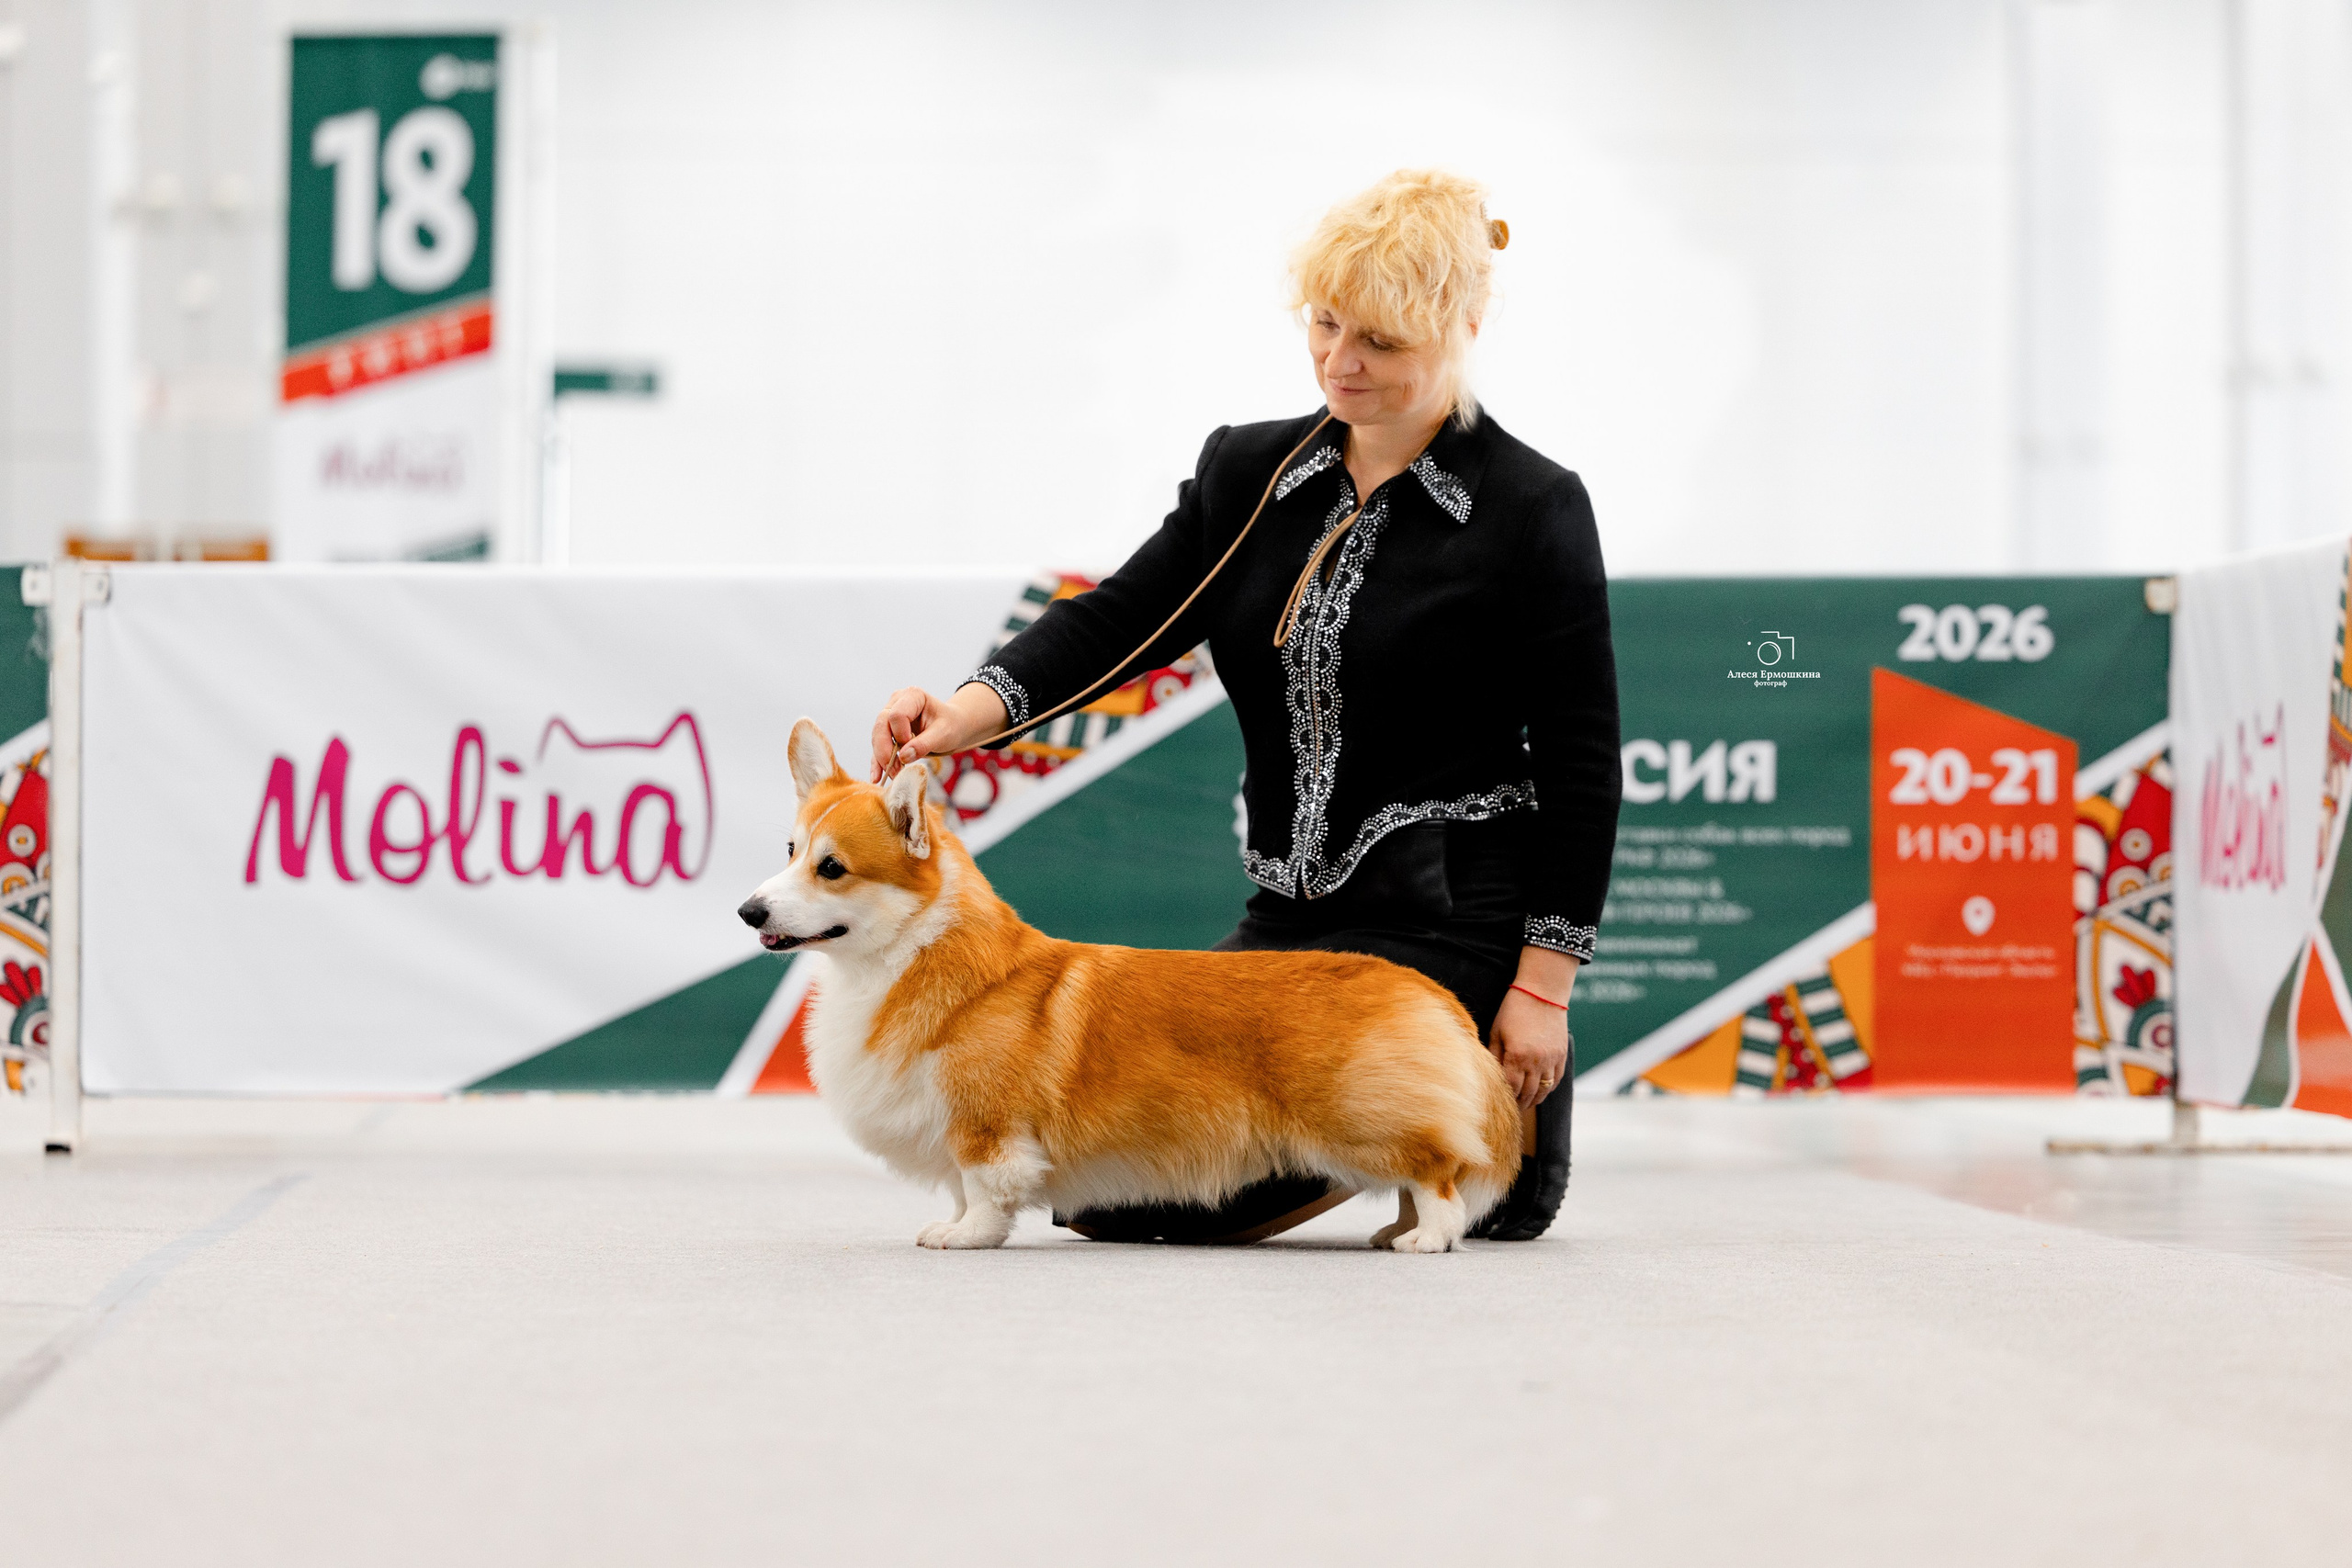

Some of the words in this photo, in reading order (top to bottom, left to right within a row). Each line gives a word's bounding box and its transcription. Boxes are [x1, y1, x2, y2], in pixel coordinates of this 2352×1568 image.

[312, 107, 478, 292] 18
[1897, 604, 2054, 662] 2026
[243, 710, 713, 888] Molina
[1889, 748, 2058, 806] 20-21
[1896, 823, 2058, 863] ИЮНЯ
